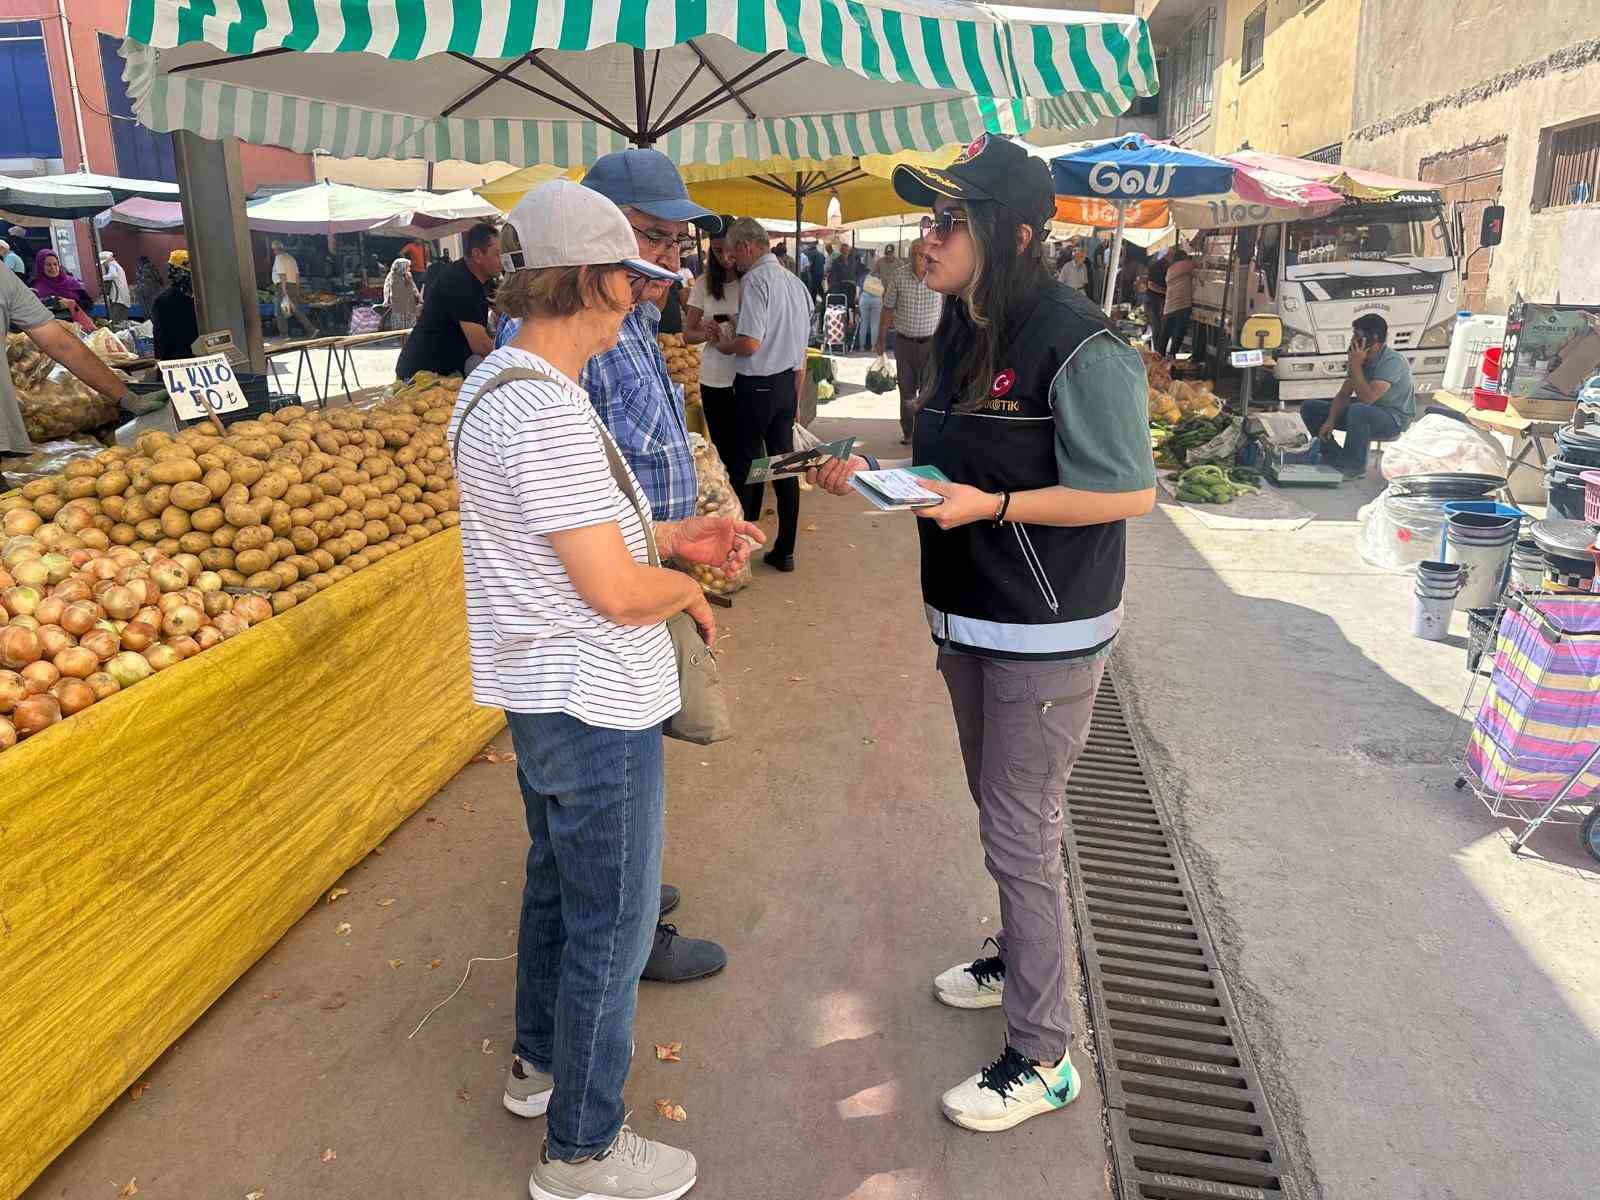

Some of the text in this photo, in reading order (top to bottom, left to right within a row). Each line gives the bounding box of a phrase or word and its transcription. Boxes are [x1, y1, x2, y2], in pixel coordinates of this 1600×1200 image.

[1088, 161, 1178, 196] Golf
[1351, 287, 1396, 298] ISUZU
[168, 364, 232, 393] 4 KILO
